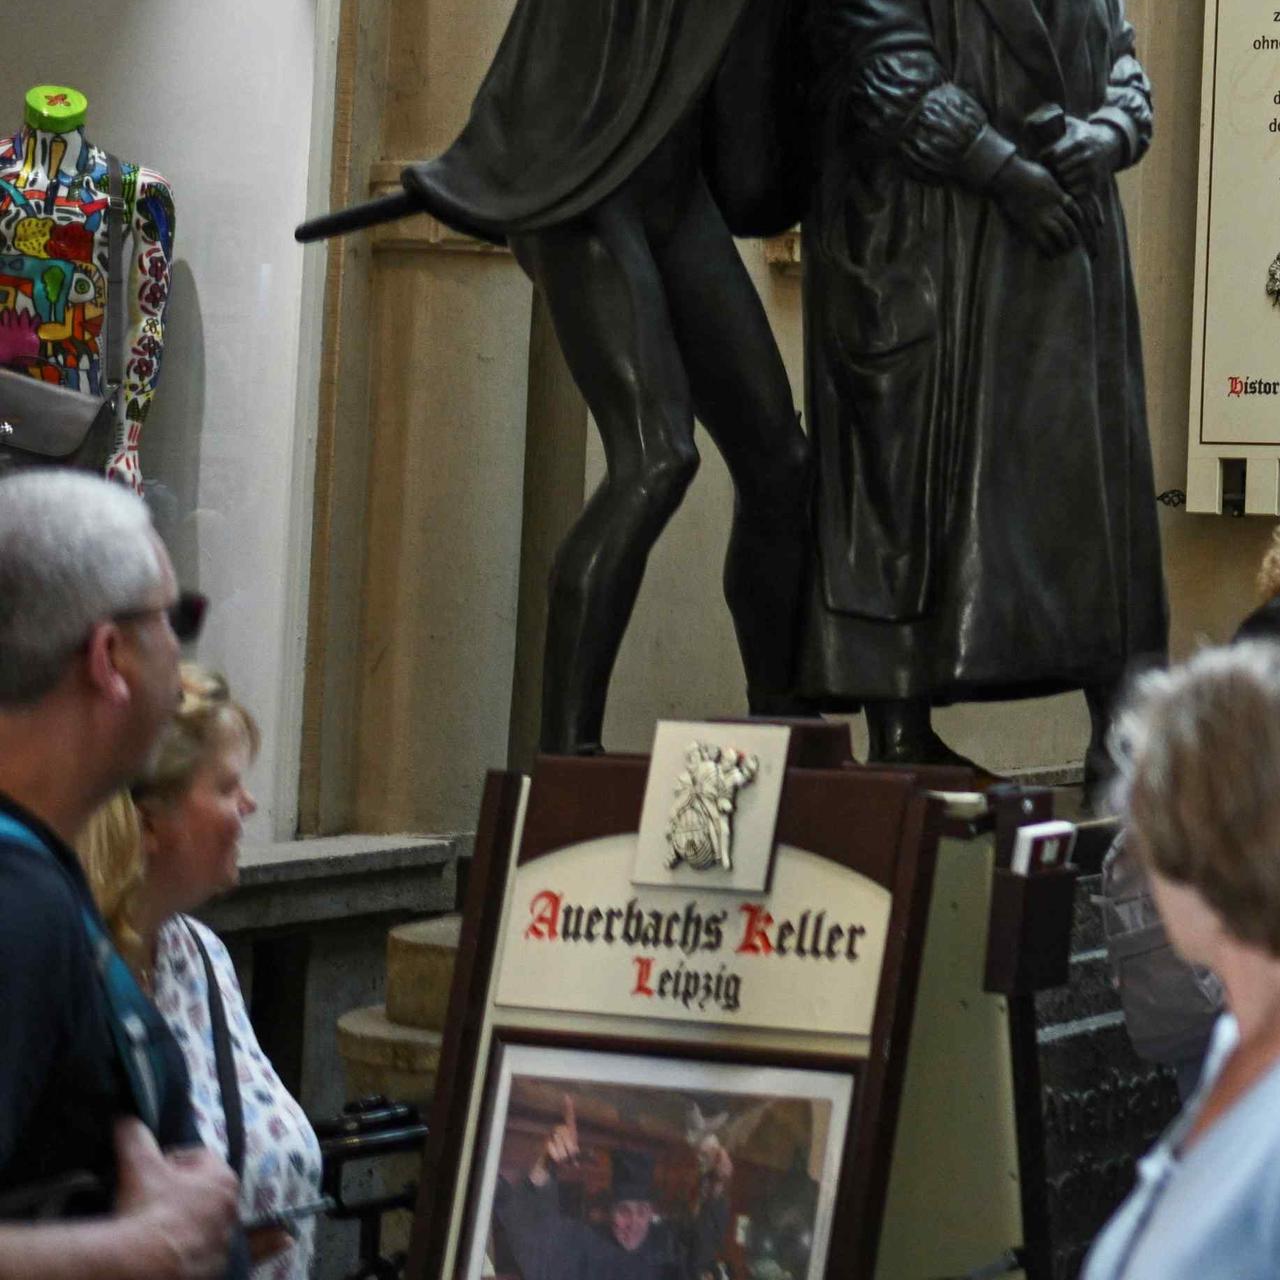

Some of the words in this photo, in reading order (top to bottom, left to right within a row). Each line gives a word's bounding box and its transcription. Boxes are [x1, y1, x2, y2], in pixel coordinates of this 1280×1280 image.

[524, 890, 728, 956] Auerbachs
[735, 902, 867, 960] Keller
[631, 955, 741, 1010] Leipzig
